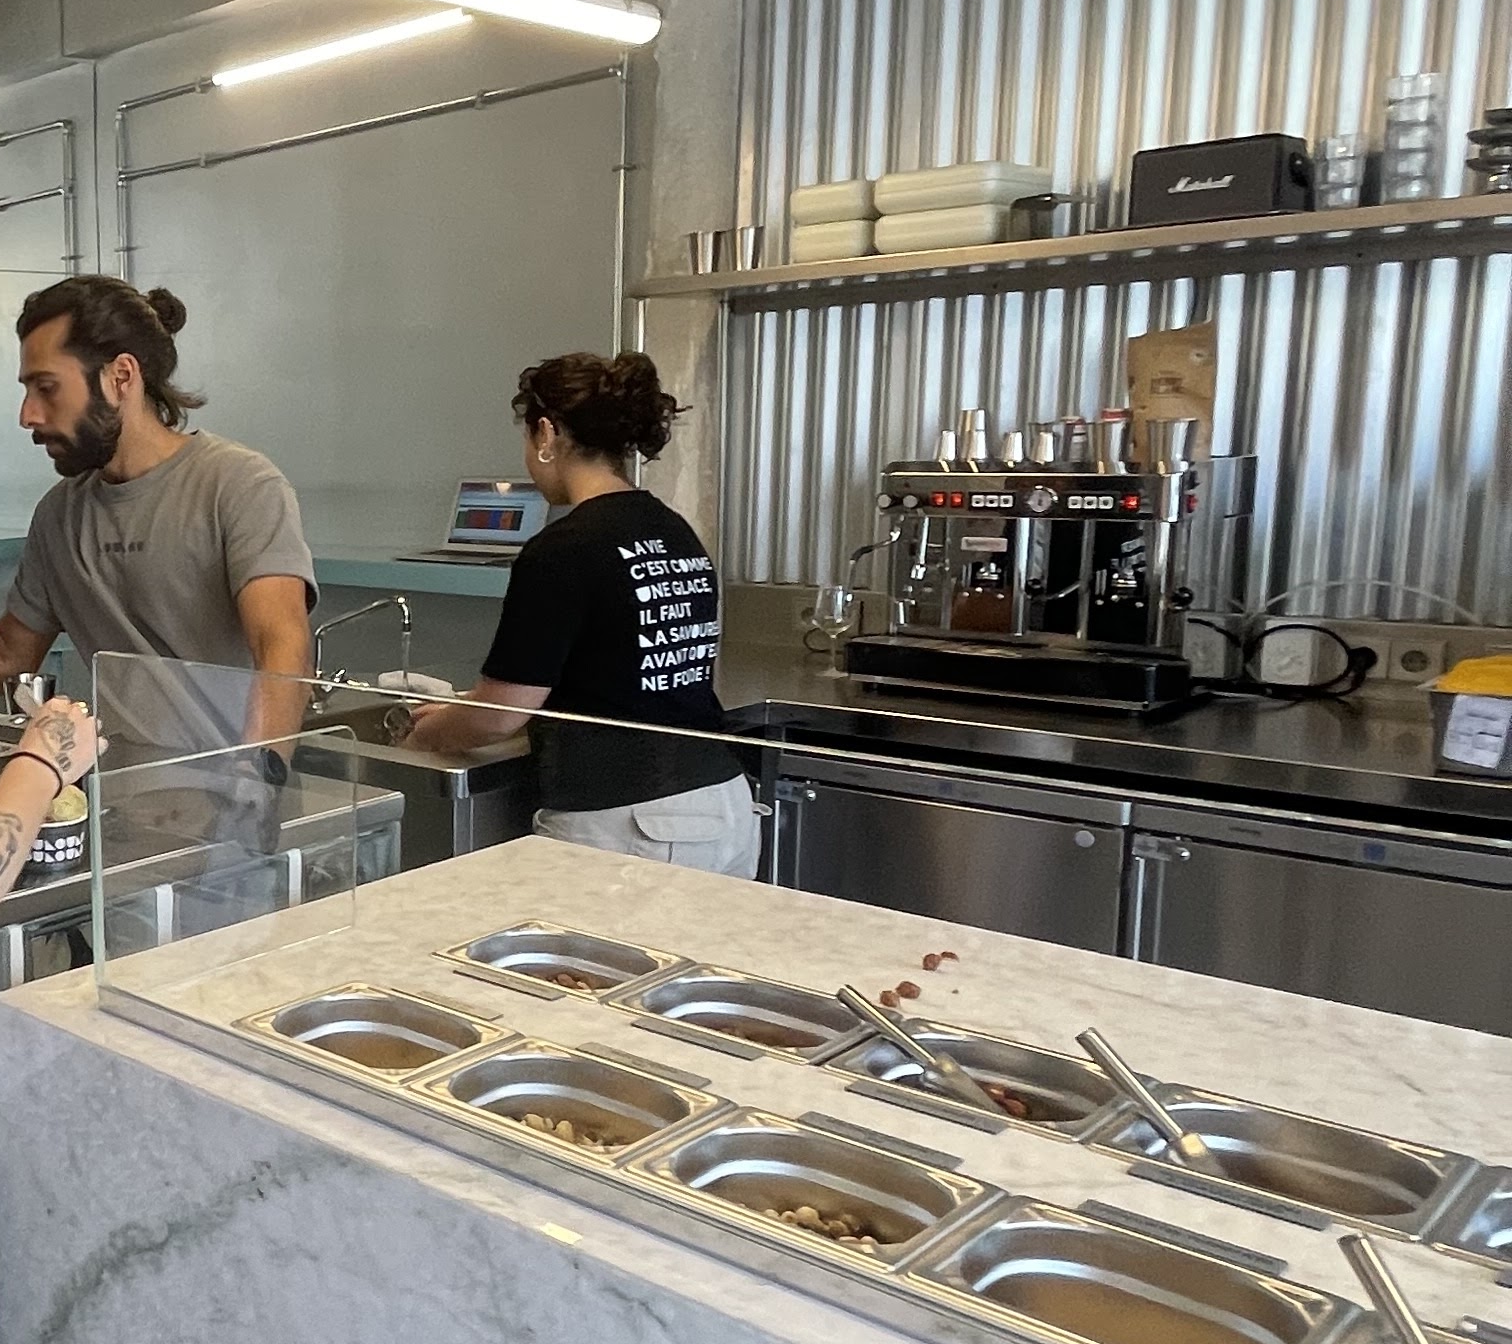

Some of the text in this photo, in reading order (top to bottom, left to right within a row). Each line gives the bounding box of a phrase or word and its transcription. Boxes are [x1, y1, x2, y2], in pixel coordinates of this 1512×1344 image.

[617, 539, 667, 559] LA VIE
[630, 560, 670, 580] C'EST
[635, 581, 672, 603] UNE
[639, 602, 691, 626] IL FAUT
[638, 629, 668, 648] LA
[641, 674, 669, 691] NE
